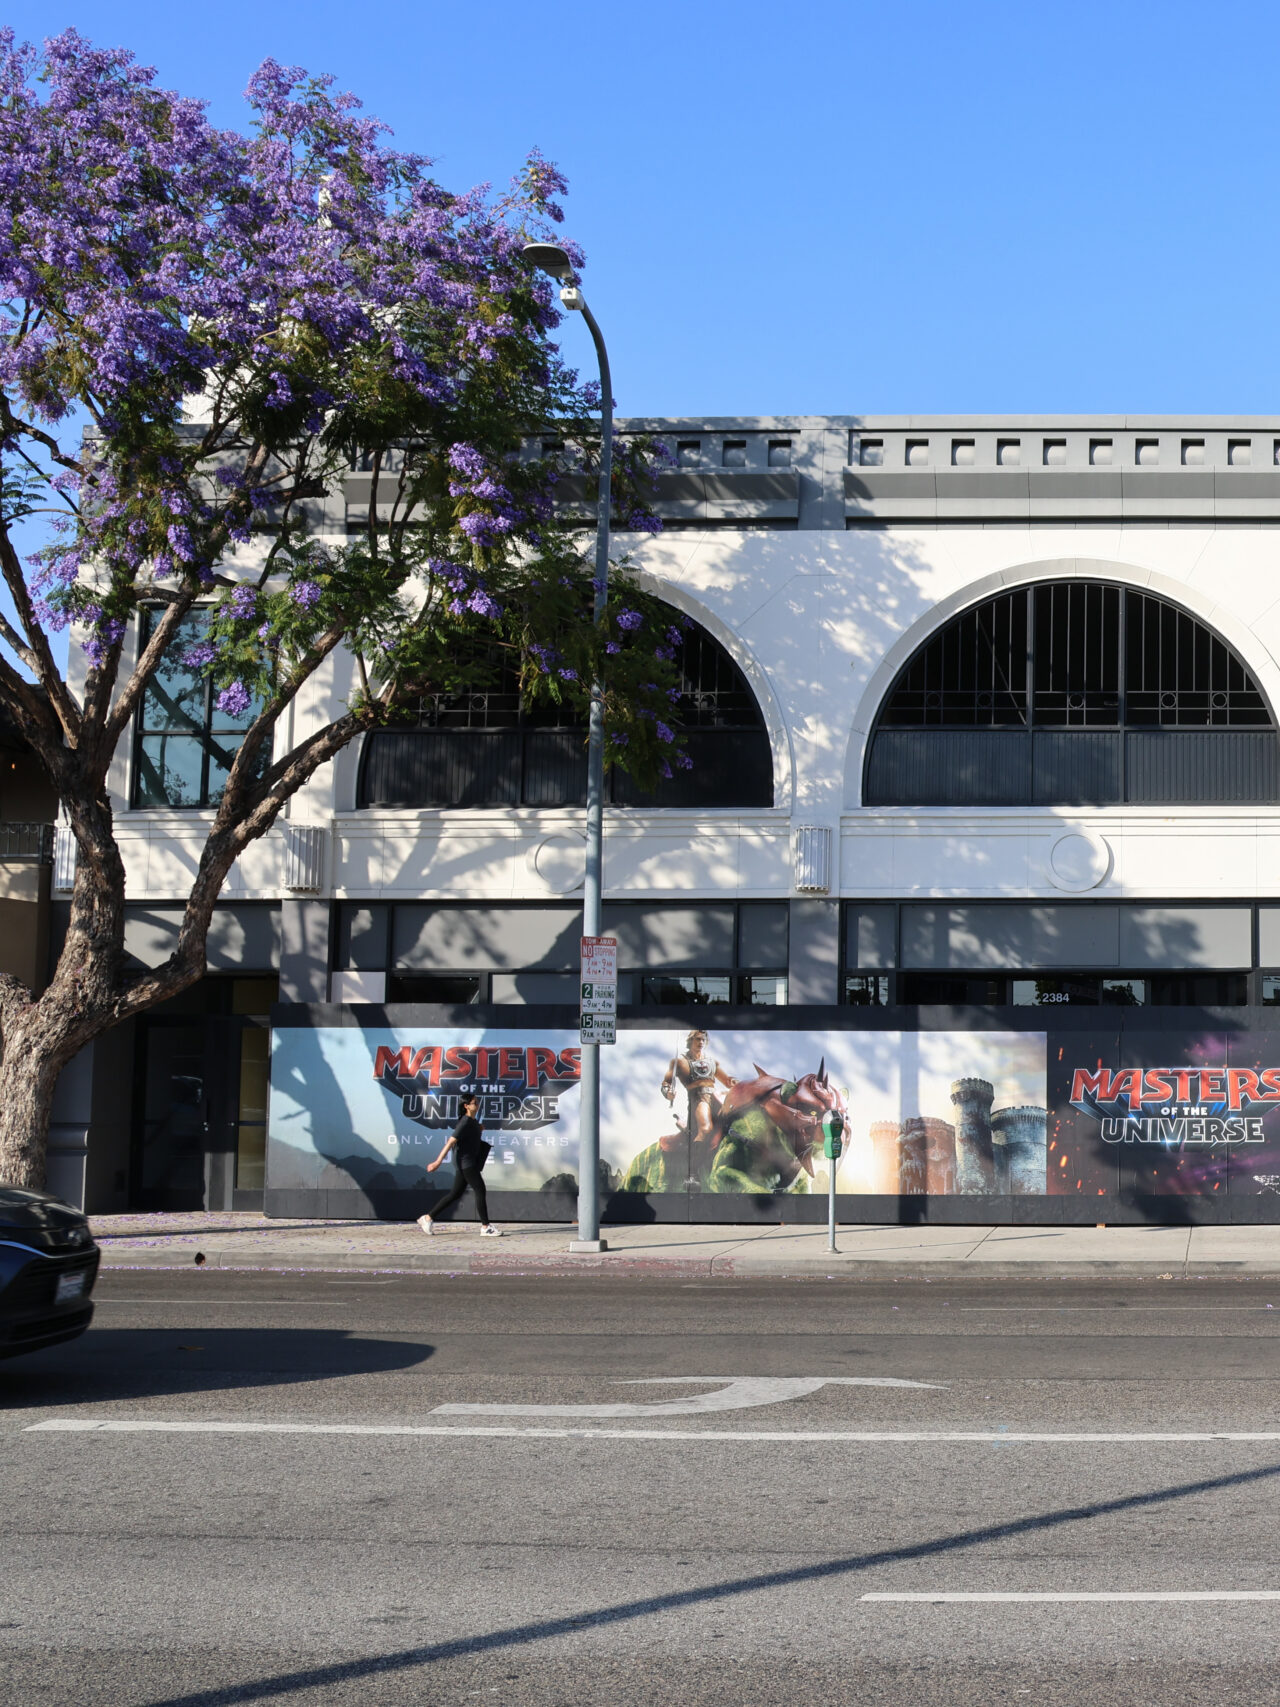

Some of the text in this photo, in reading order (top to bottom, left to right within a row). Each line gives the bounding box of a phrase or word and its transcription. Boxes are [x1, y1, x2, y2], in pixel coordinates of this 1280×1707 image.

[583, 945, 593, 957] NO
[584, 984, 591, 998] 2
[594, 990, 615, 999] PARKING
[1042, 992, 1070, 1003] 2384
[582, 1015, 615, 1030] 15 PARKING
[372, 1045, 582, 1090] MASTERS
[459, 1083, 506, 1093] OF THE
[1160, 1106, 1208, 1116] OF THE
[1101, 1117, 1265, 1143] UNIVERSE
[387, 1134, 433, 1145] ONLY
[485, 1135, 570, 1147] HEATERS
[503, 1151, 516, 1165] 5
